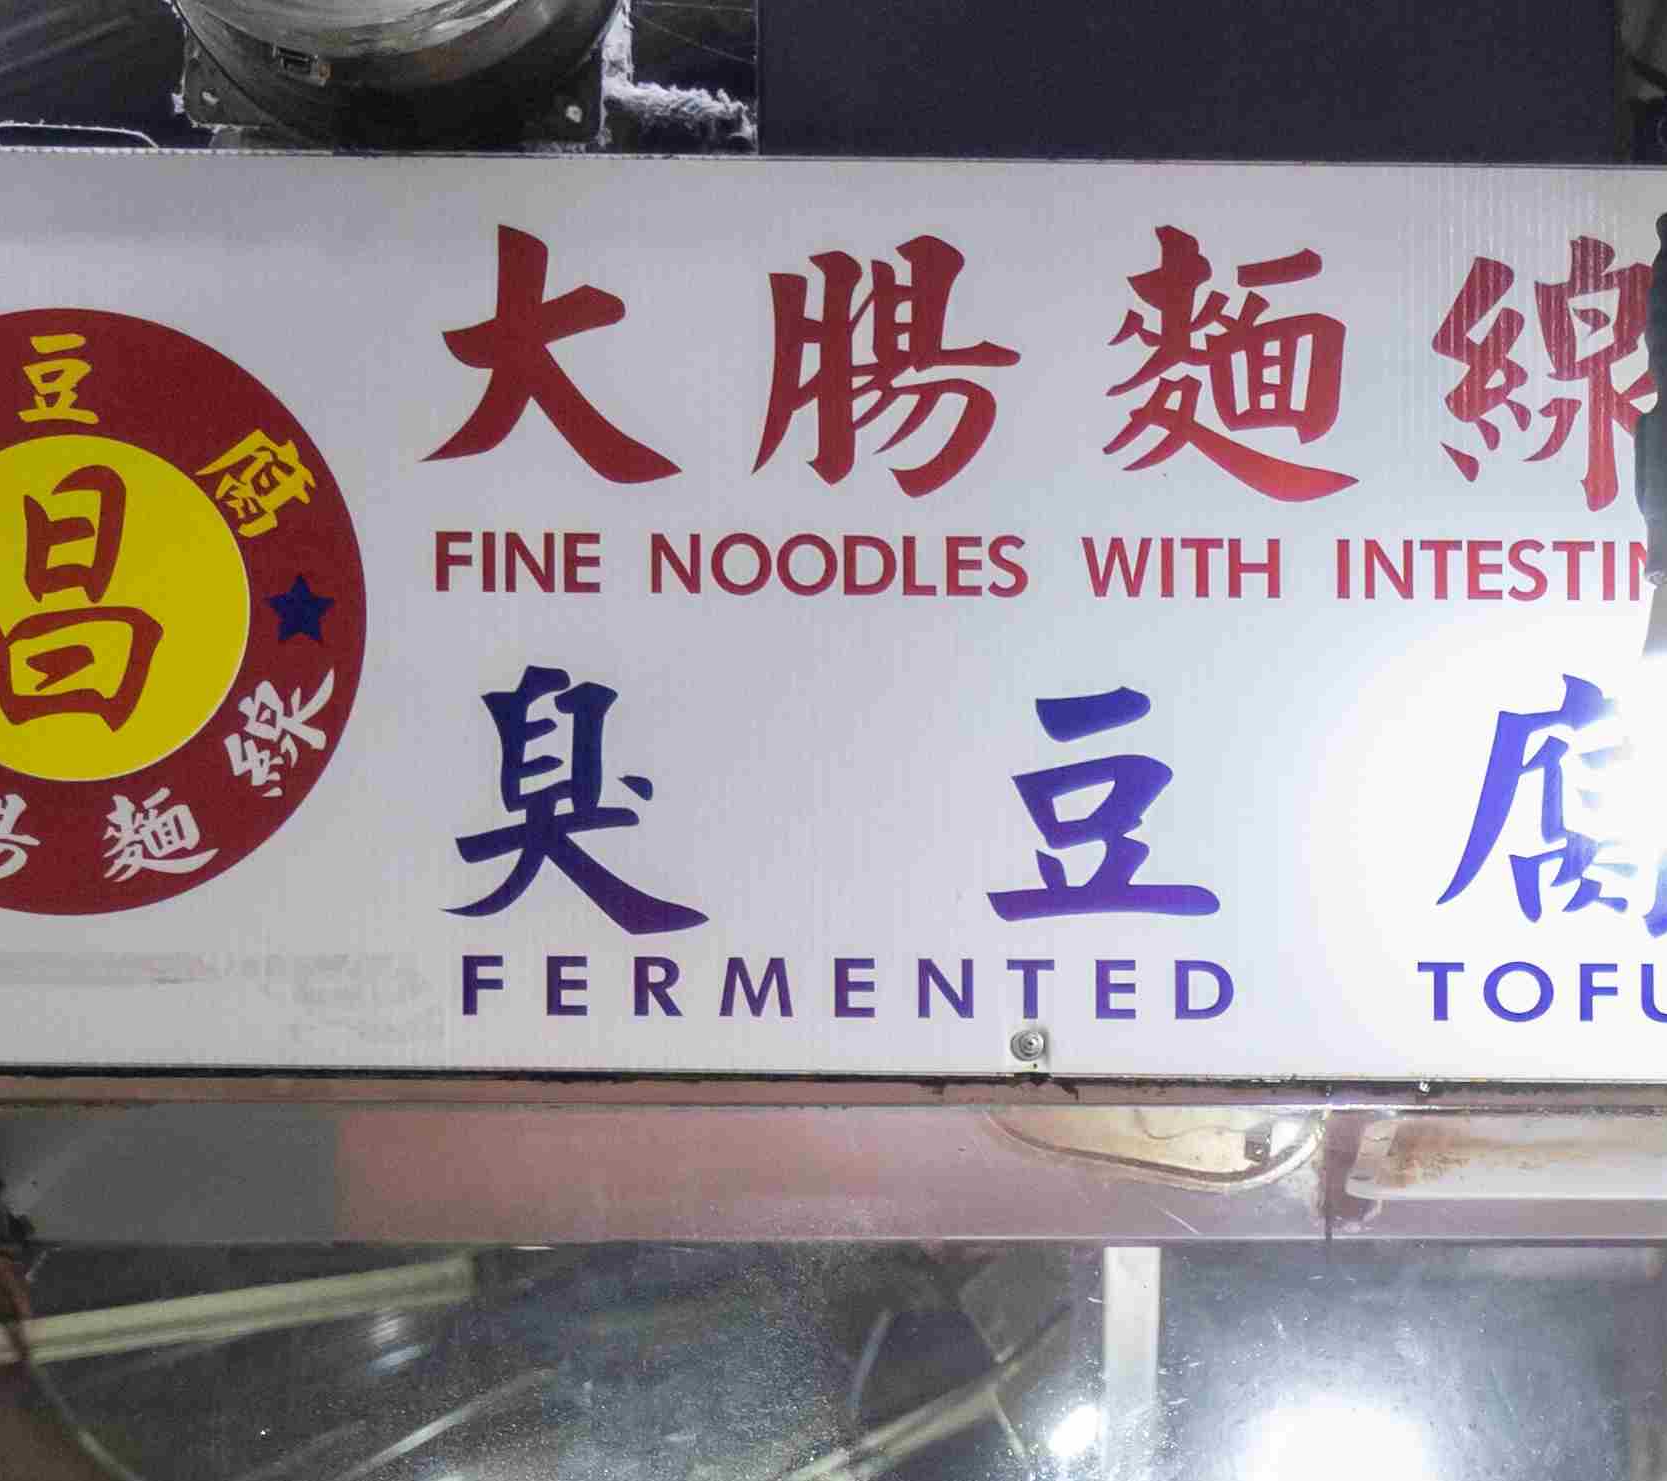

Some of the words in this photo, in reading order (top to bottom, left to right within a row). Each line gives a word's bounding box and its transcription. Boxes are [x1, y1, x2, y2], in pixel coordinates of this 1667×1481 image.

[421, 223, 1658, 512] 大腸麵線
[436, 531, 600, 593] FINE
[651, 533, 1027, 597] NOODLES
[1082, 537, 1280, 598] WITH
[462, 955, 1233, 1019] FERMENTED
